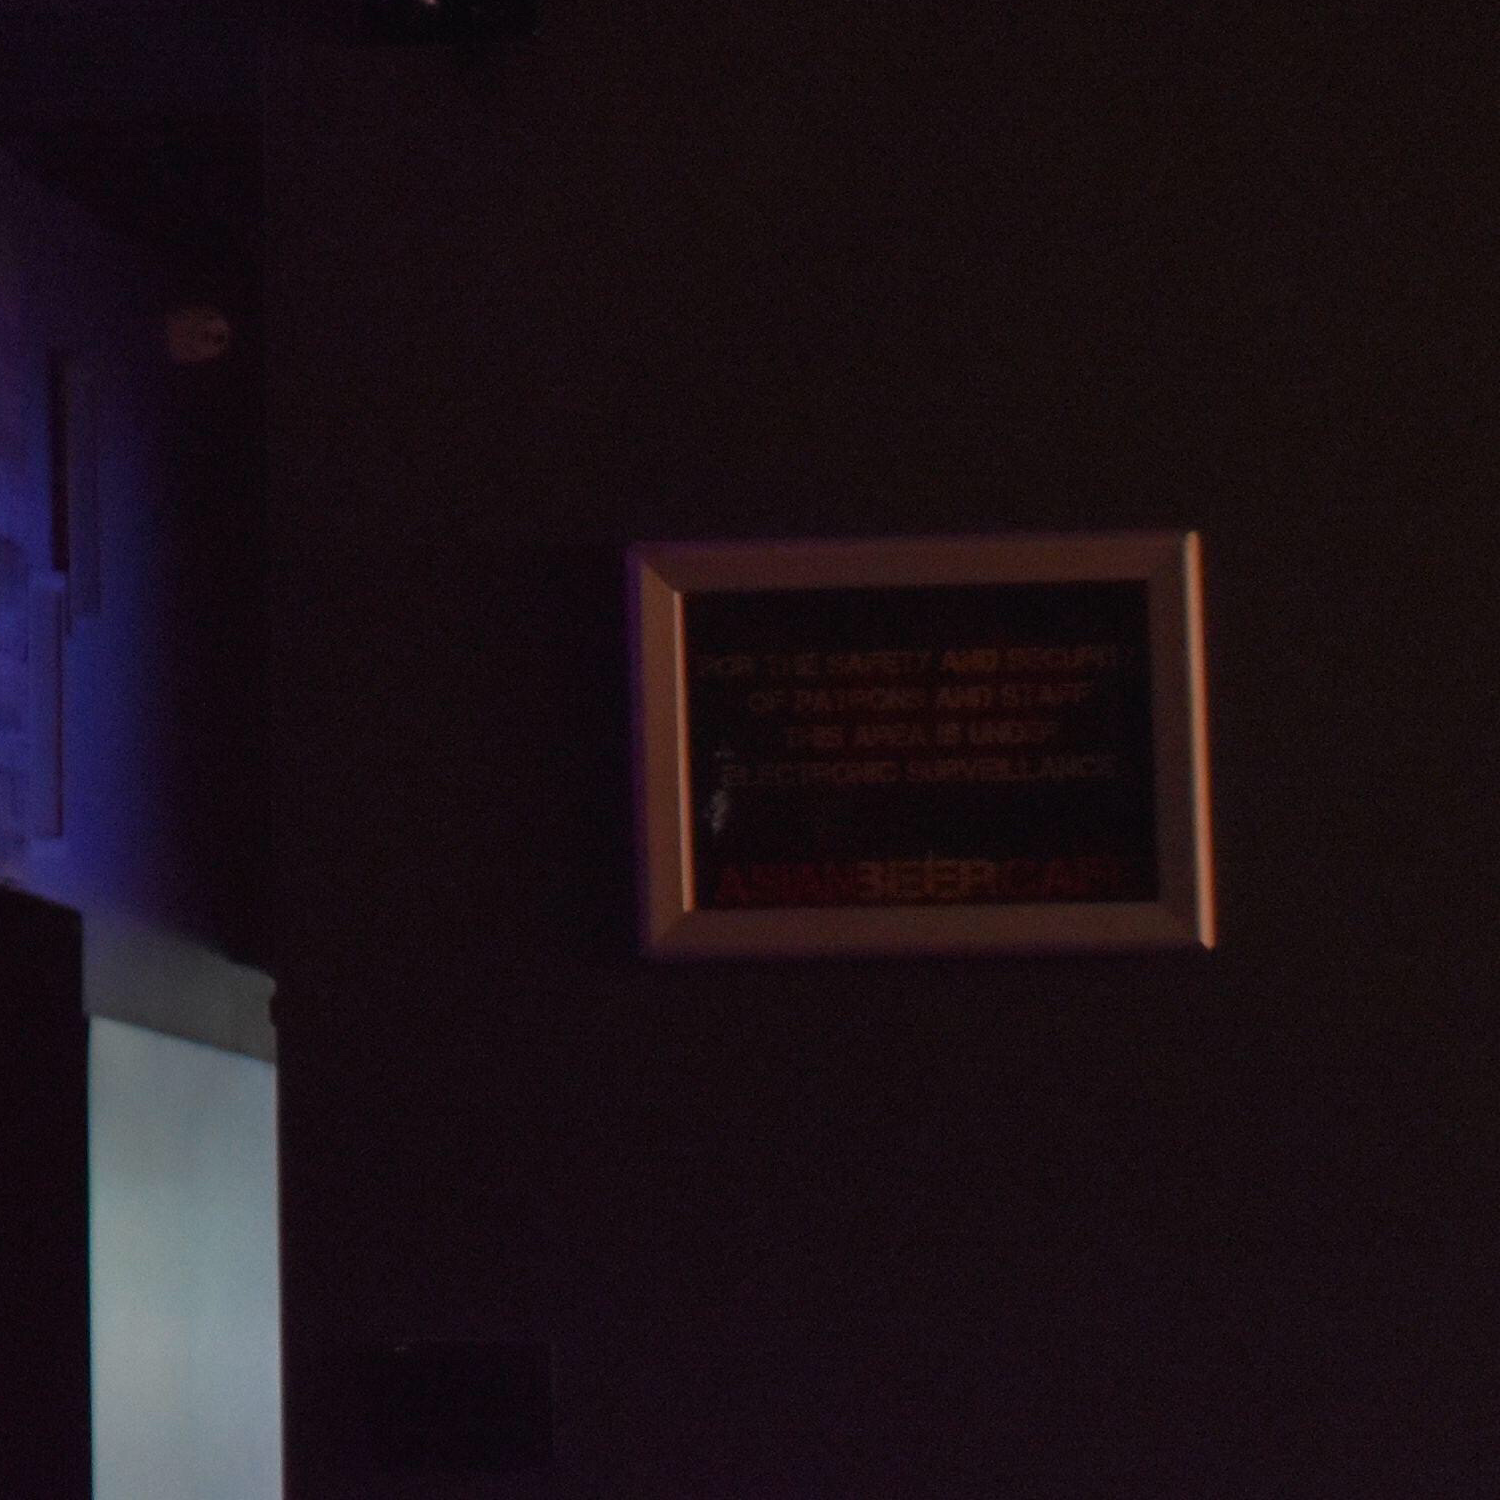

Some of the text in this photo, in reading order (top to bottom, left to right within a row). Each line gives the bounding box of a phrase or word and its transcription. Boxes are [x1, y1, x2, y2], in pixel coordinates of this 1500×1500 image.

[941, 647, 998, 673] AND
[936, 684, 993, 711] AND
[1000, 680, 1098, 708] STAFF
[851, 721, 928, 747] AREA
[936, 719, 962, 746] IS
